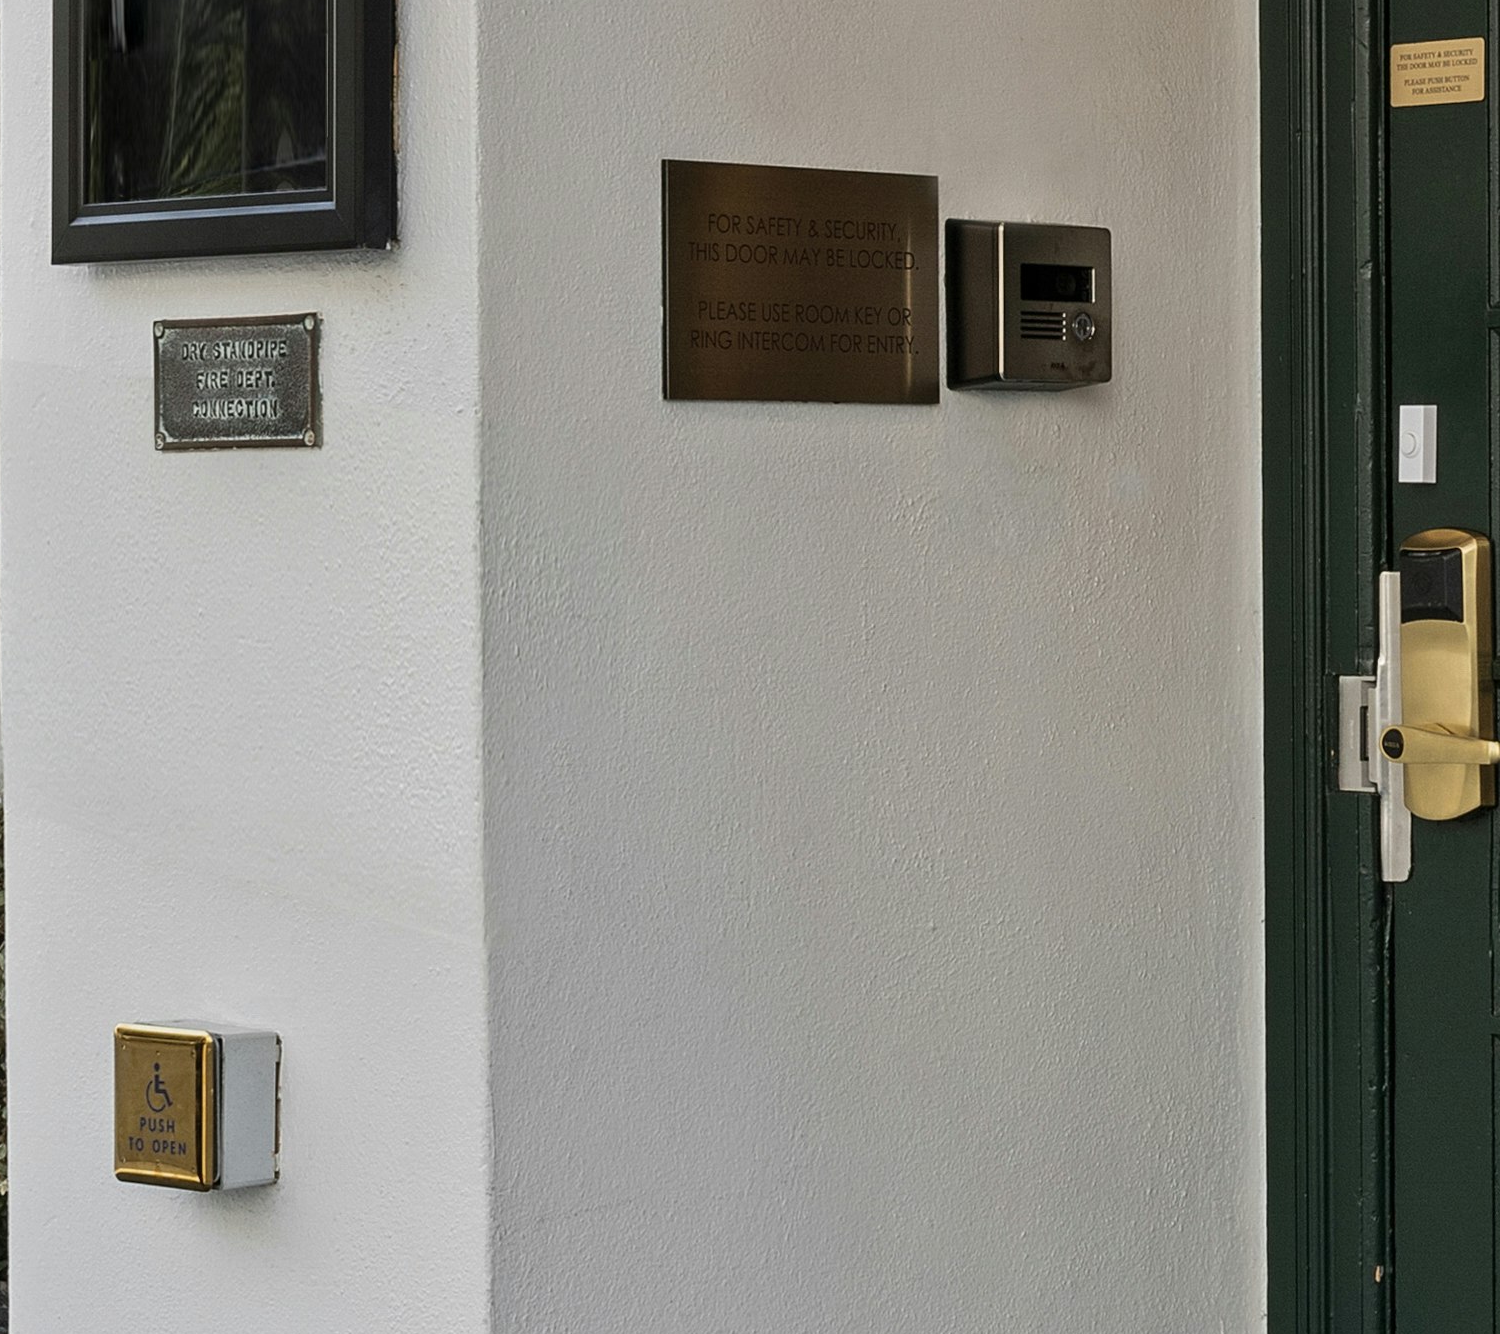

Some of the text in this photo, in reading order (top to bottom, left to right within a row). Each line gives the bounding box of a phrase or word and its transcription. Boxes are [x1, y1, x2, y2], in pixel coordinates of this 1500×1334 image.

[1413, 51, 1436, 59] SAFETY
[1443, 48, 1473, 57] SECURITY
[1409, 62, 1427, 70] DOOR
[1428, 60, 1441, 69] MAY
[1443, 59, 1451, 67] BE
[1451, 58, 1478, 67] LOCKED
[1404, 75, 1470, 86] PLEASE PUSH BUTTON
[1411, 85, 1462, 95] FOR ASSISTANCE
[708, 213, 901, 244] FOR SAFETY & SECURITY,
[687, 241, 920, 271] THIS DOOR MAY BE LOCKED.
[699, 300, 912, 327] PLEASE USE ROOM KEY OR
[181, 339, 287, 361] DRY STANDPIPE
[690, 330, 920, 356] RING INTERCOM FOR ENTRY.
[196, 369, 276, 389] FIRE DEPT.
[191, 398, 279, 419] CONNECTION
[140, 1116, 176, 1134] PUSH
[128, 1136, 187, 1156] TO OPEN
